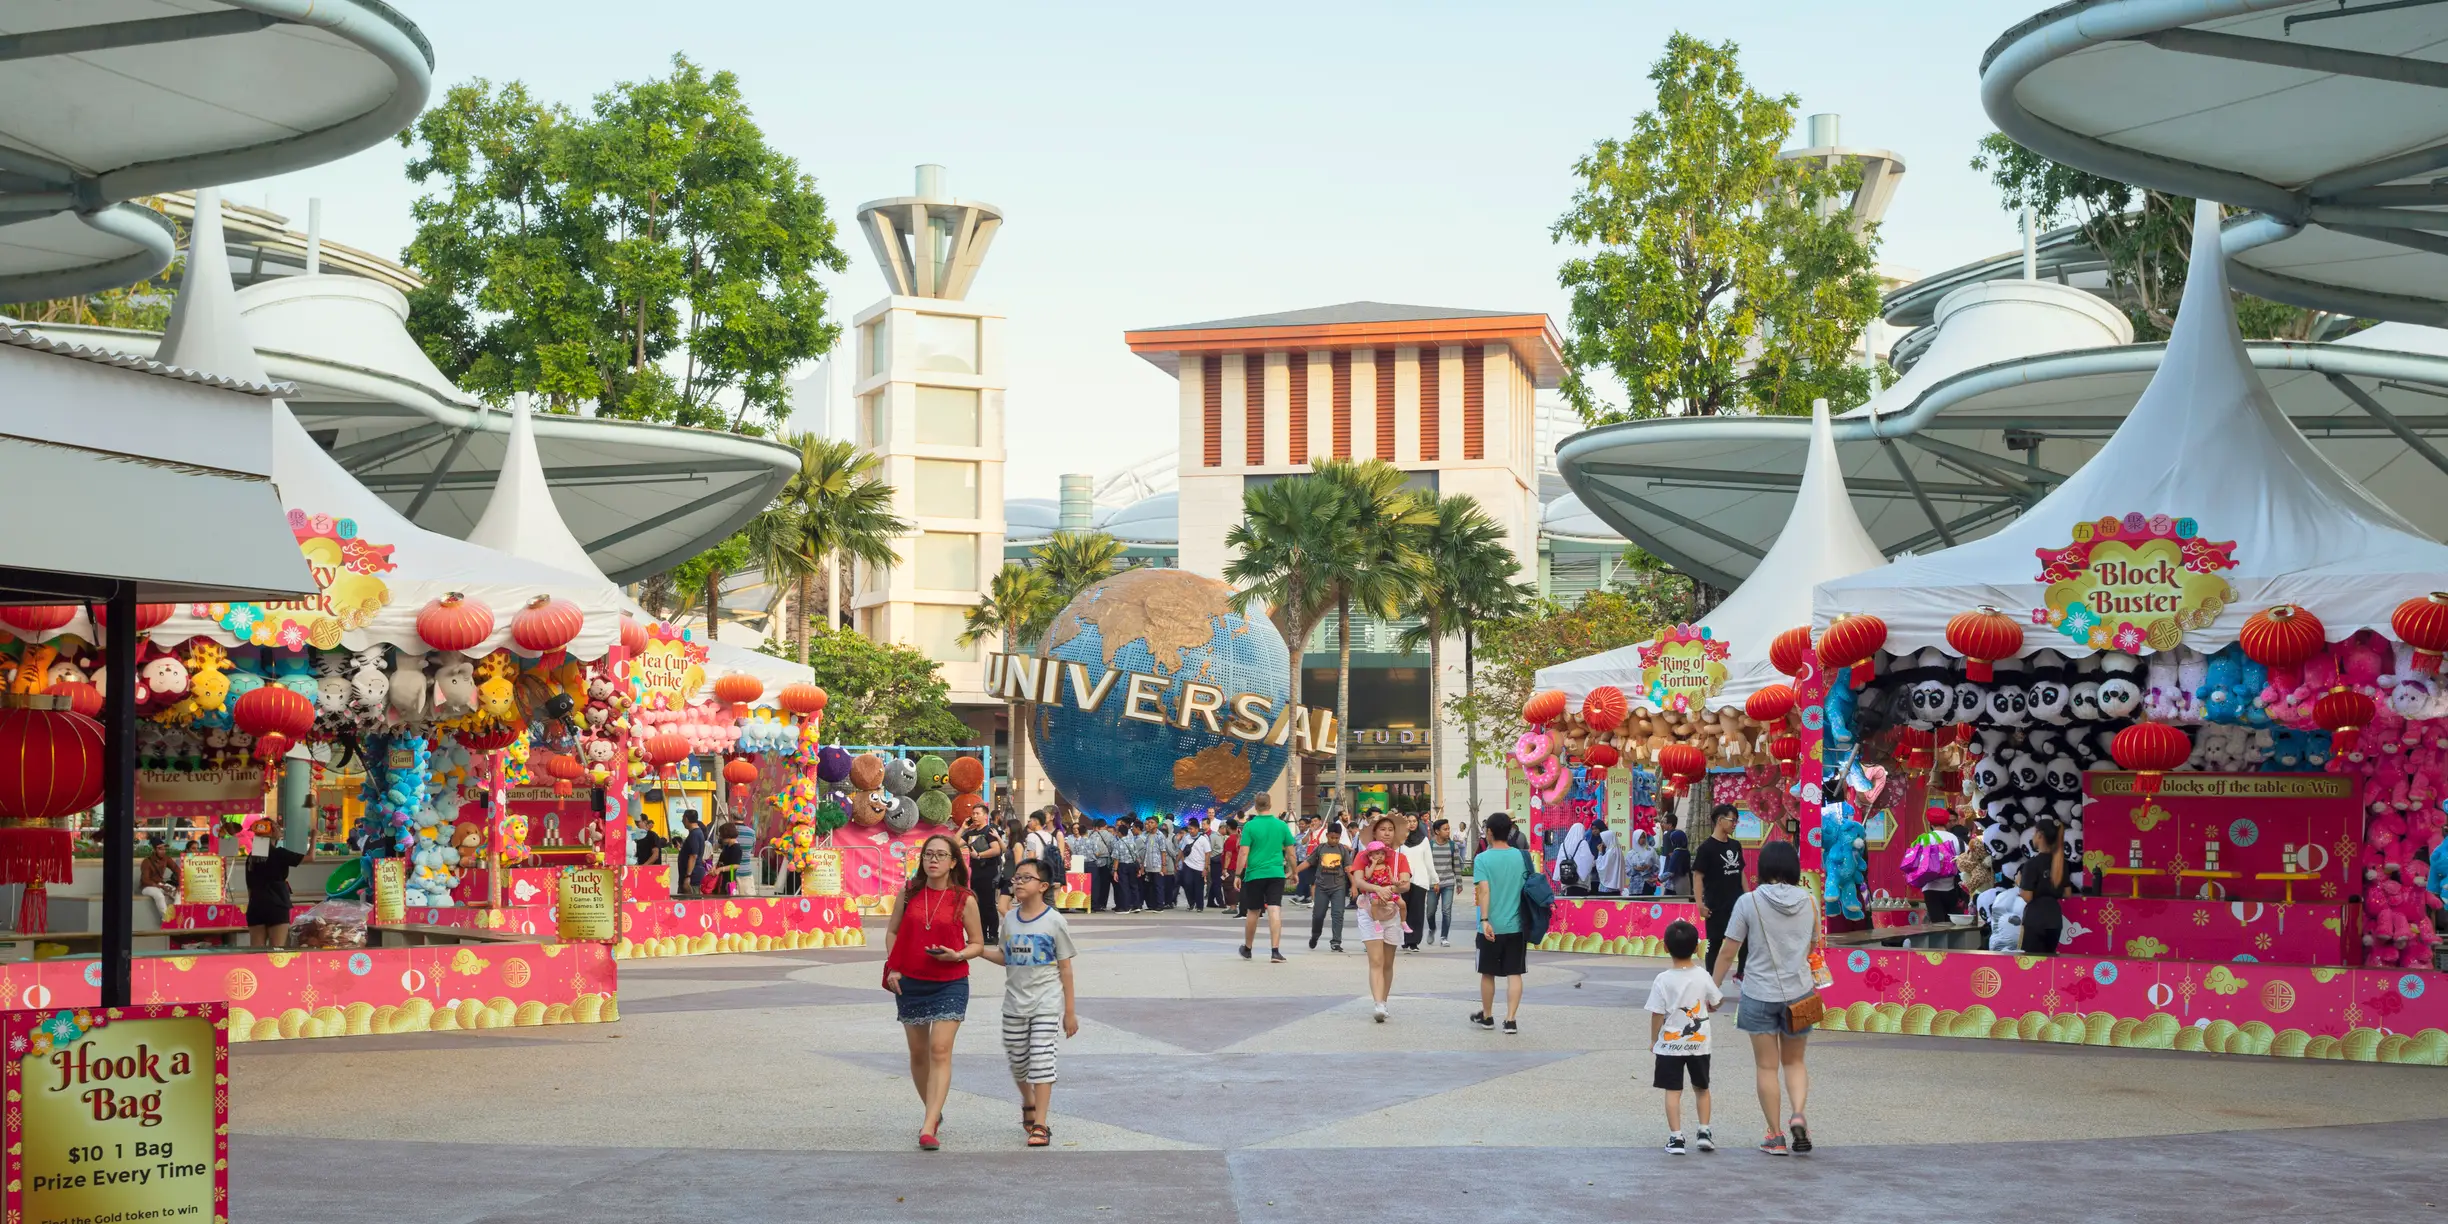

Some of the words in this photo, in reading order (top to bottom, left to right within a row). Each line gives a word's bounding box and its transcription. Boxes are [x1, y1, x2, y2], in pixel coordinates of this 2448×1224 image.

[2094, 560, 2182, 588] Block
[2088, 590, 2182, 614] Buster
[639, 652, 661, 668] Tea
[665, 653, 688, 674] Cup
[1660, 656, 1690, 674] Ring
[1693, 653, 1707, 673] of
[644, 670, 681, 690] Strike
[1660, 673, 1708, 687] Fortune
[983, 652, 1338, 757] UNIVERSAL
[143, 769, 180, 783] Prize
[184, 770, 223, 785] Every
[226, 768, 259, 781] Time
[1510, 776, 1529, 786] Hang
[1610, 774, 1628, 785] Hang
[507, 790, 525, 798] cans
[527, 789, 539, 800] off
[540, 789, 553, 798] the
[576, 790, 585, 798] to
[1613, 789, 1622, 798] for
[2163, 779, 2204, 794] blocks
[2207, 779, 2226, 796] off
[2230, 780, 2250, 794] the
[2254, 780, 2287, 794] table
[2291, 781, 2304, 793] to
[2308, 780, 2339, 794] Win
[186, 859, 219, 867] Treasure
[569, 872, 603, 885] Lucky
[570, 884, 602, 896] Duck
[48, 1041, 170, 1092] Hook
[169, 1051, 192, 1076] a
[81, 1087, 163, 1127] Bag
[68, 1144, 104, 1165] $10
[114, 1143, 122, 1159] 1
[135, 1141, 173, 1161] Bag
[33, 1173, 87, 1192] Prize
[93, 1167, 151, 1186] Every
[157, 1162, 207, 1179] Time
[94, 1212, 122, 1224] Gold
[125, 1209, 159, 1221] token
[162, 1207, 175, 1217] to
[177, 1204, 198, 1215] win
